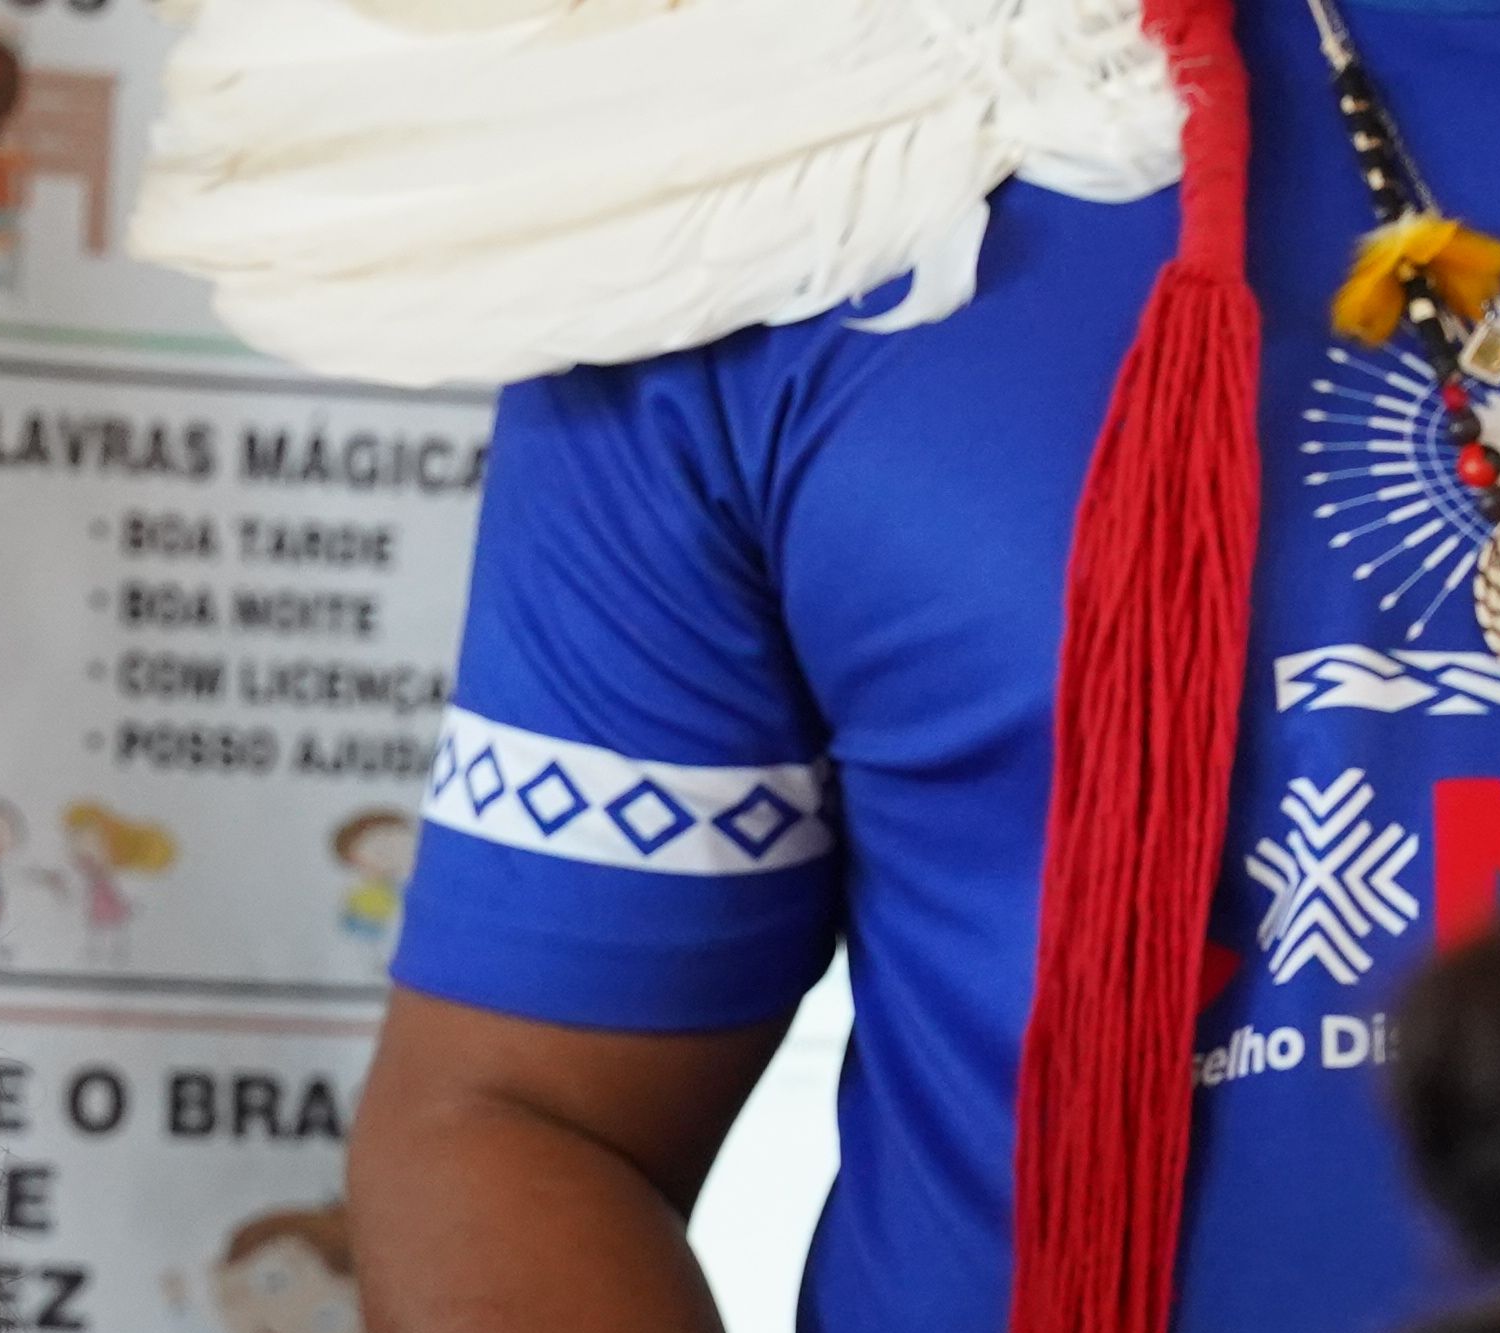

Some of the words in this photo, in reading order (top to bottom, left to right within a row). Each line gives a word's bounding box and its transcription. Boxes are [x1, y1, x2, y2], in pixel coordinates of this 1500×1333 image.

[119, 513, 218, 560] BOA
[239, 518, 392, 568] TARDE
[119, 577, 218, 630] BOA
[232, 588, 382, 640] NOITE
[117, 648, 224, 702] COM
[239, 656, 454, 718] LICENÇA
[116, 720, 280, 776] POSSO
[296, 734, 430, 780] AJUD
[66, 1068, 130, 1138] O
[168, 1070, 346, 1140] BRA
